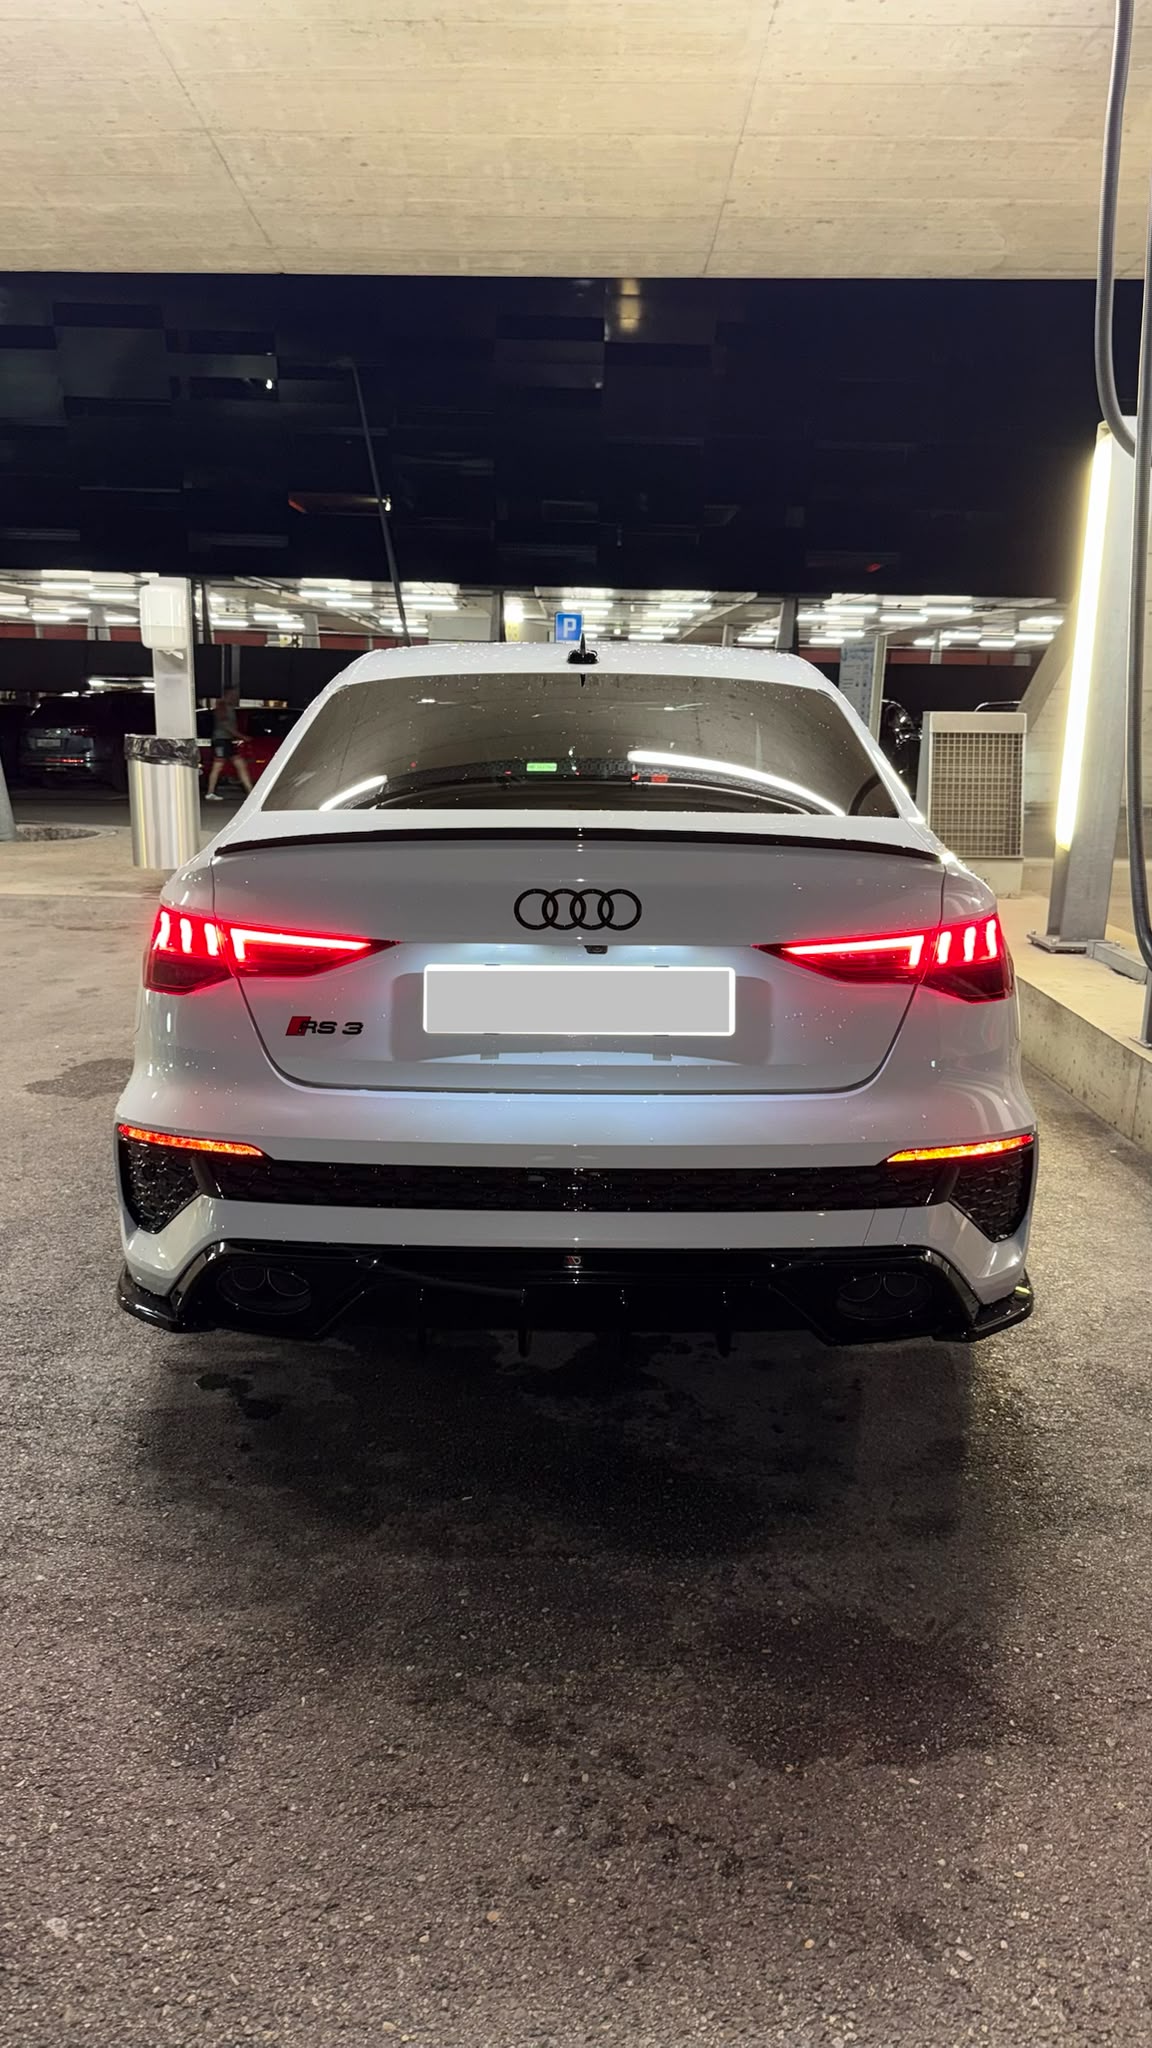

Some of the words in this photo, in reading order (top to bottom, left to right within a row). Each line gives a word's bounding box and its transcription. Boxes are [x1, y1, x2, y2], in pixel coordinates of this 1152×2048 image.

[563, 617, 577, 638] P
[296, 1020, 338, 1035] RS
[342, 1021, 364, 1035] 3
